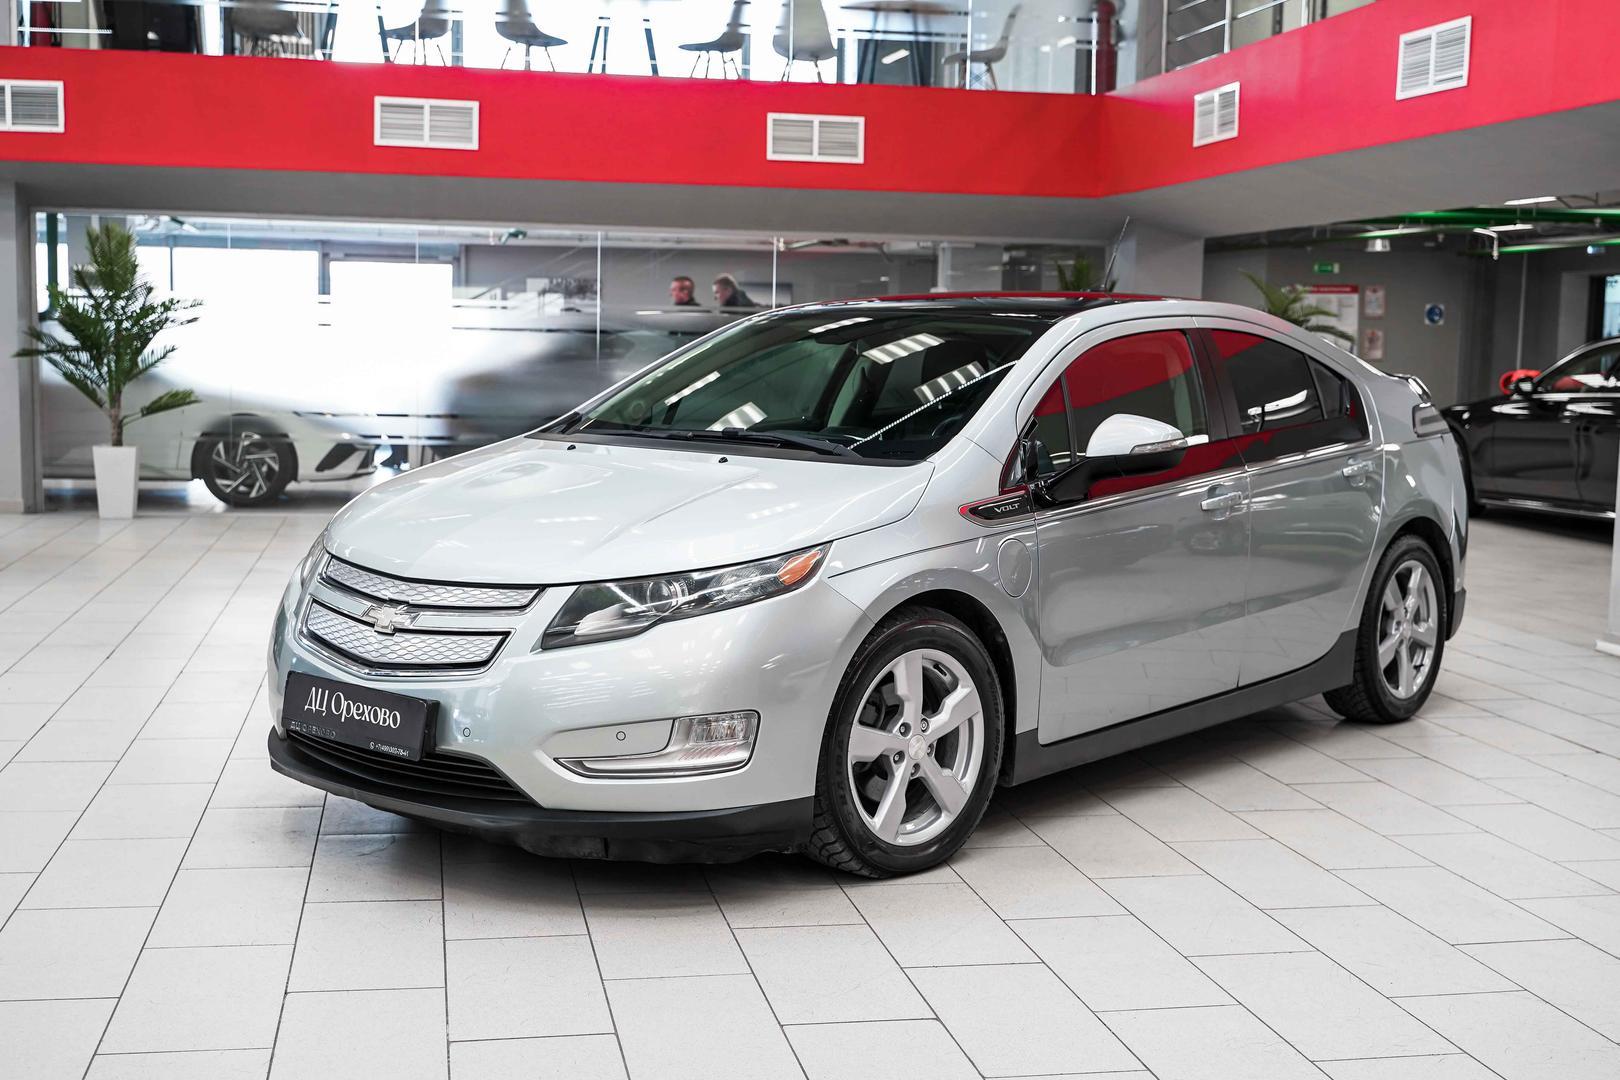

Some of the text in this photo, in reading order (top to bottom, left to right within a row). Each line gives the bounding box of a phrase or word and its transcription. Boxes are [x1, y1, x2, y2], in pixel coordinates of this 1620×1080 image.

[994, 503, 1020, 513] VOLT
[304, 686, 401, 729] ДЦ Орехово
